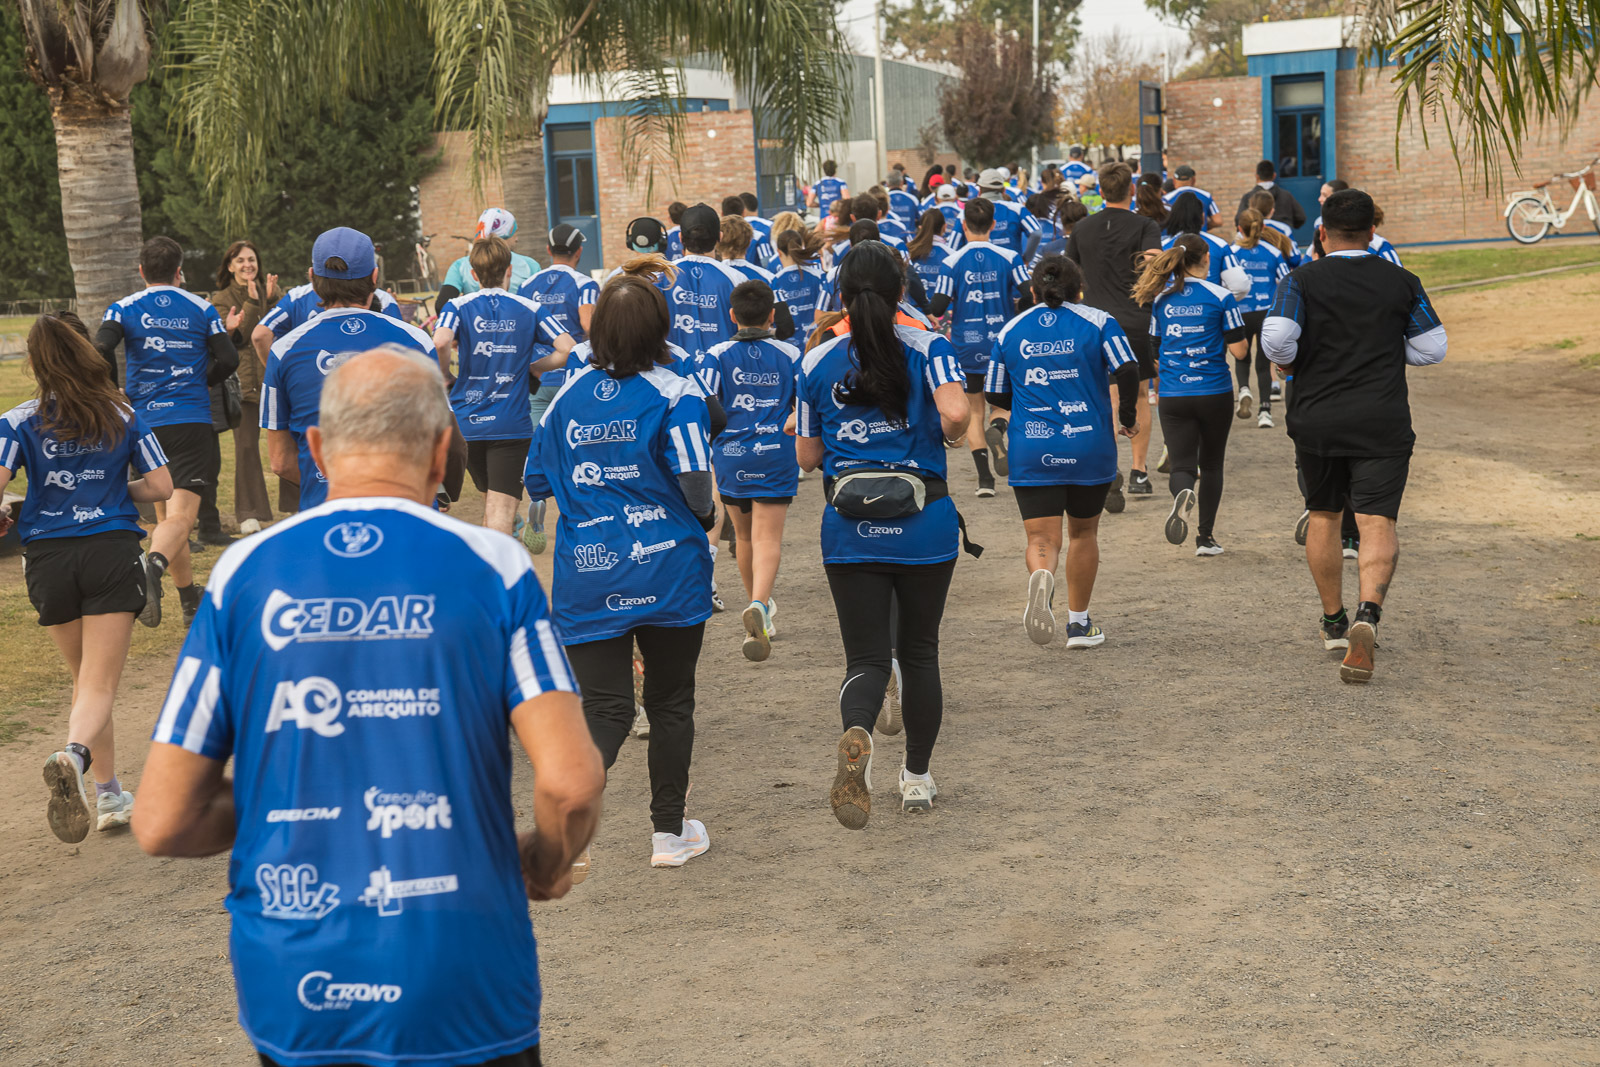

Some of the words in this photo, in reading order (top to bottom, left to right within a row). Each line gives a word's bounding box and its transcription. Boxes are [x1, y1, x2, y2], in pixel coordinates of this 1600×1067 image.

[1020, 339, 1074, 359] CEDAR
[732, 367, 779, 386] CEDAR
[1024, 367, 1050, 386] AQ
[731, 394, 755, 411] AQ
[566, 419, 637, 449] CEDAR
[837, 419, 869, 443] AQ
[42, 438, 103, 459] CED
[44, 470, 76, 490] AQ
[572, 462, 605, 488] AQ
[574, 543, 607, 569] SCC
[262, 590, 435, 648] CEDAR
[346, 689, 415, 702] COMUNA
[418, 688, 440, 701] DE
[265, 677, 345, 737] AQ
[347, 702, 441, 719] AREQUITO
[256, 864, 320, 916] SCC
